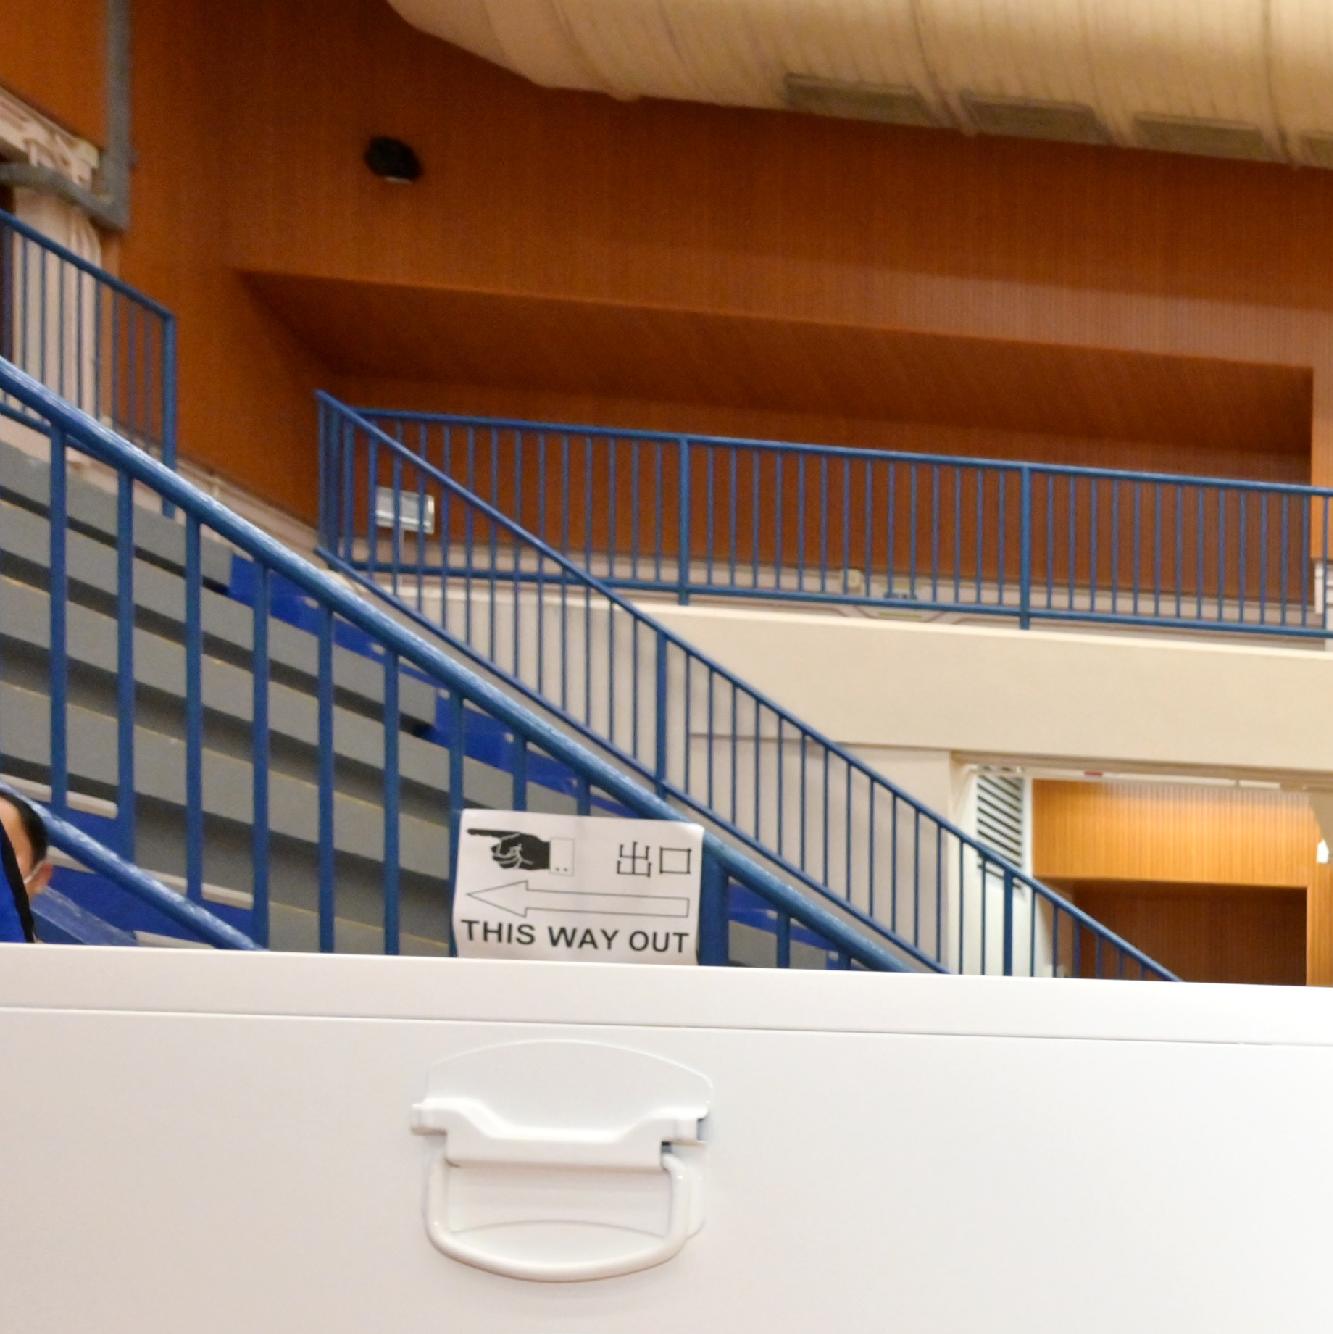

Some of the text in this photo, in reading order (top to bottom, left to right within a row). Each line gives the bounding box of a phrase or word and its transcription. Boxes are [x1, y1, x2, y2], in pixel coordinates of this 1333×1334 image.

[616, 840, 692, 879] 出口
[461, 919, 691, 954] THIS WAY OUT
